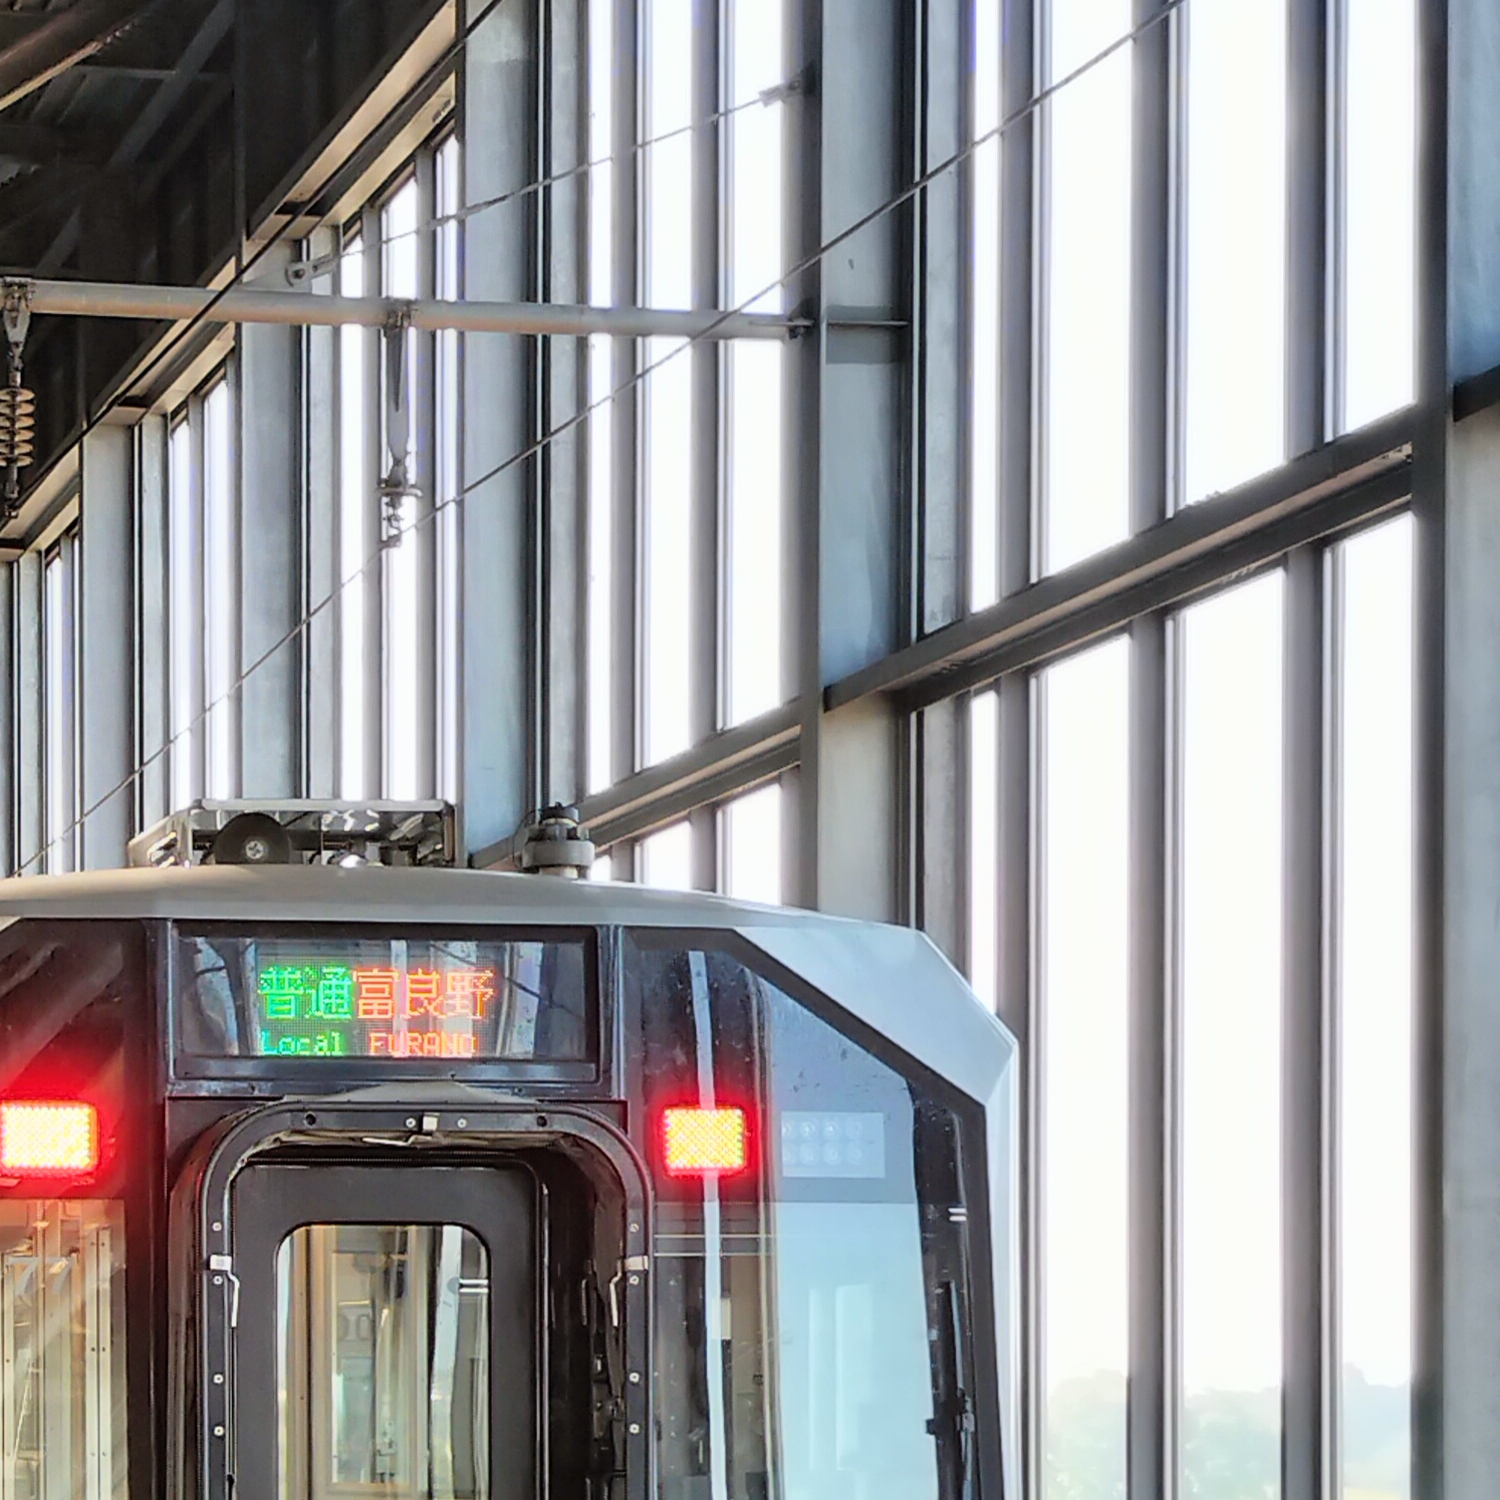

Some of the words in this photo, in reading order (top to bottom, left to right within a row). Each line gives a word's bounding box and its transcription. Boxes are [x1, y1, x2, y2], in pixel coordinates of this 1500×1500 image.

[258, 966, 351, 1019] 普通
[353, 968, 495, 1020] 富良野
[260, 1031, 343, 1056] Local
[368, 1032, 477, 1058] FURANO
